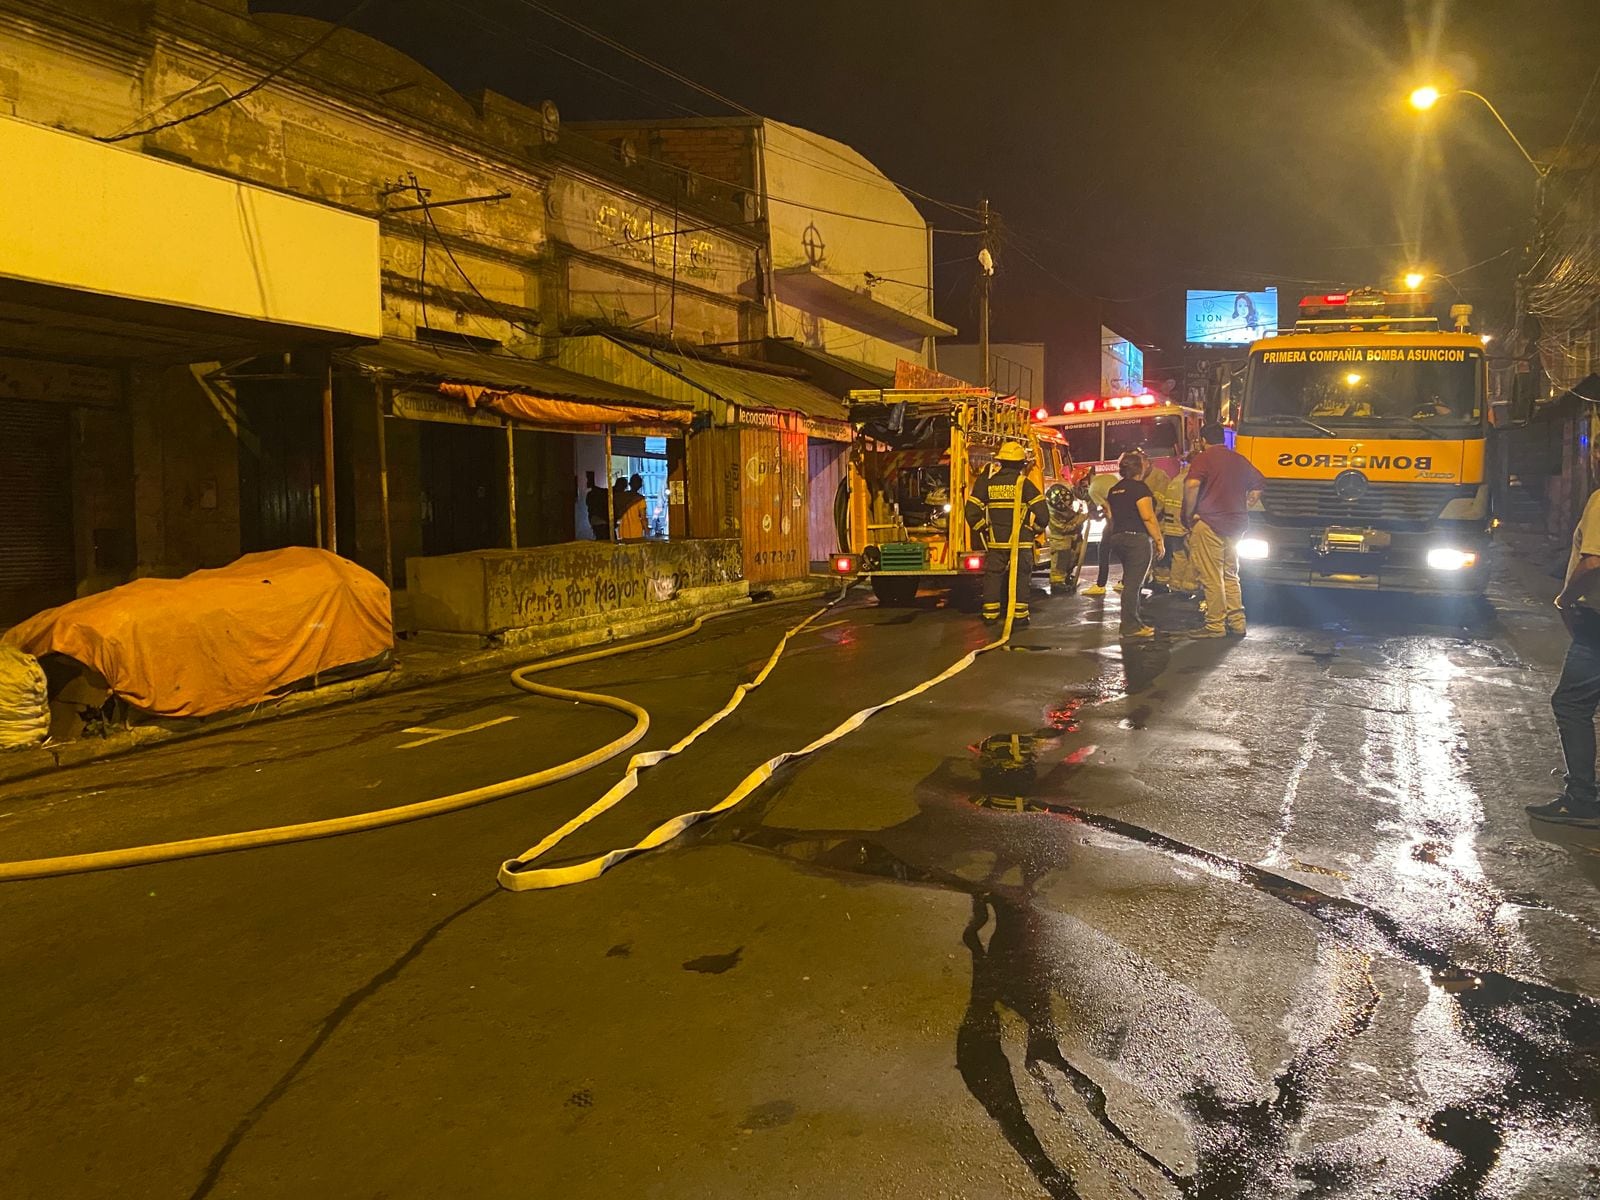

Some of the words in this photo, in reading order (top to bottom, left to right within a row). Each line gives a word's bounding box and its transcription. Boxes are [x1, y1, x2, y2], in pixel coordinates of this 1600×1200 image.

[1195, 314, 1222, 322] LION
[1263, 351, 1307, 363] PRIMERA
[1367, 350, 1404, 361] BOMBA
[1407, 350, 1465, 362] ASUNCION
[1065, 422, 1100, 430] BOMBEROS
[565, 578, 591, 606] Por
[595, 572, 638, 607] Mayor
